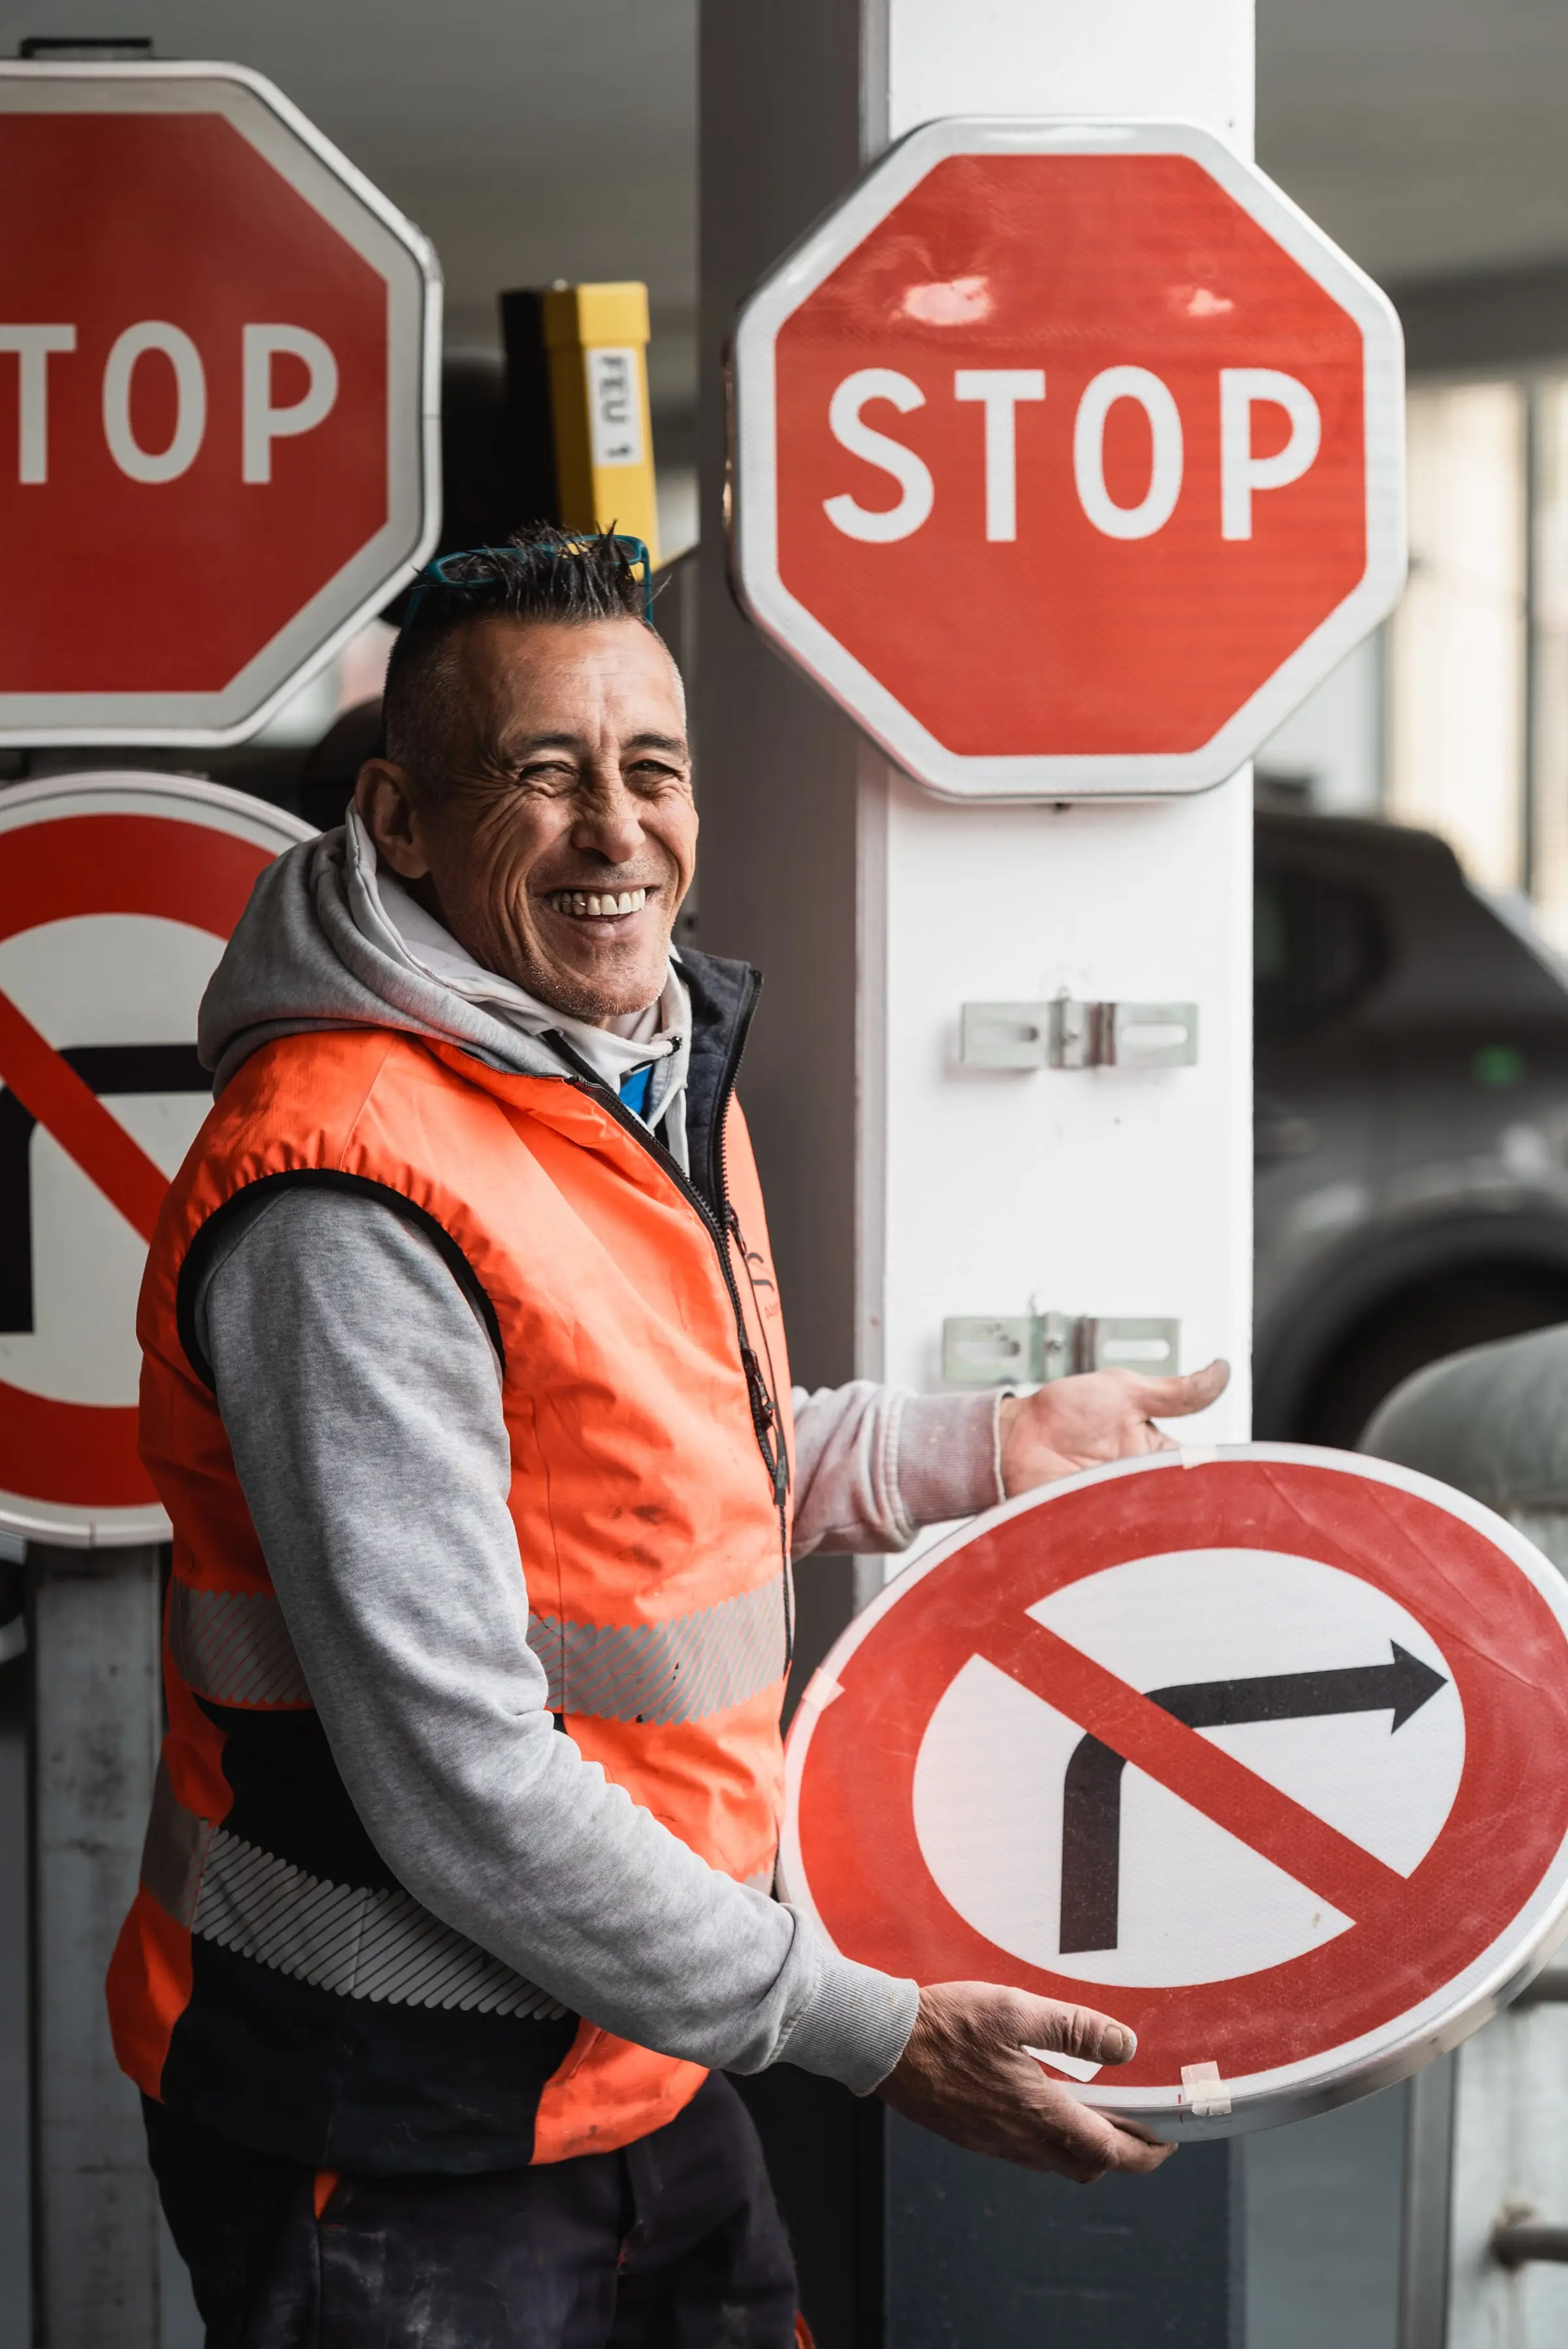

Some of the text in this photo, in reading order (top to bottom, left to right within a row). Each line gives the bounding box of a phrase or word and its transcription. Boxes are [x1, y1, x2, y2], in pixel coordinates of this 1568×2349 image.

[0, 320, 339, 484] TOP
[599, 355, 629, 424] FEU
[823, 365, 1321, 543] STOP
